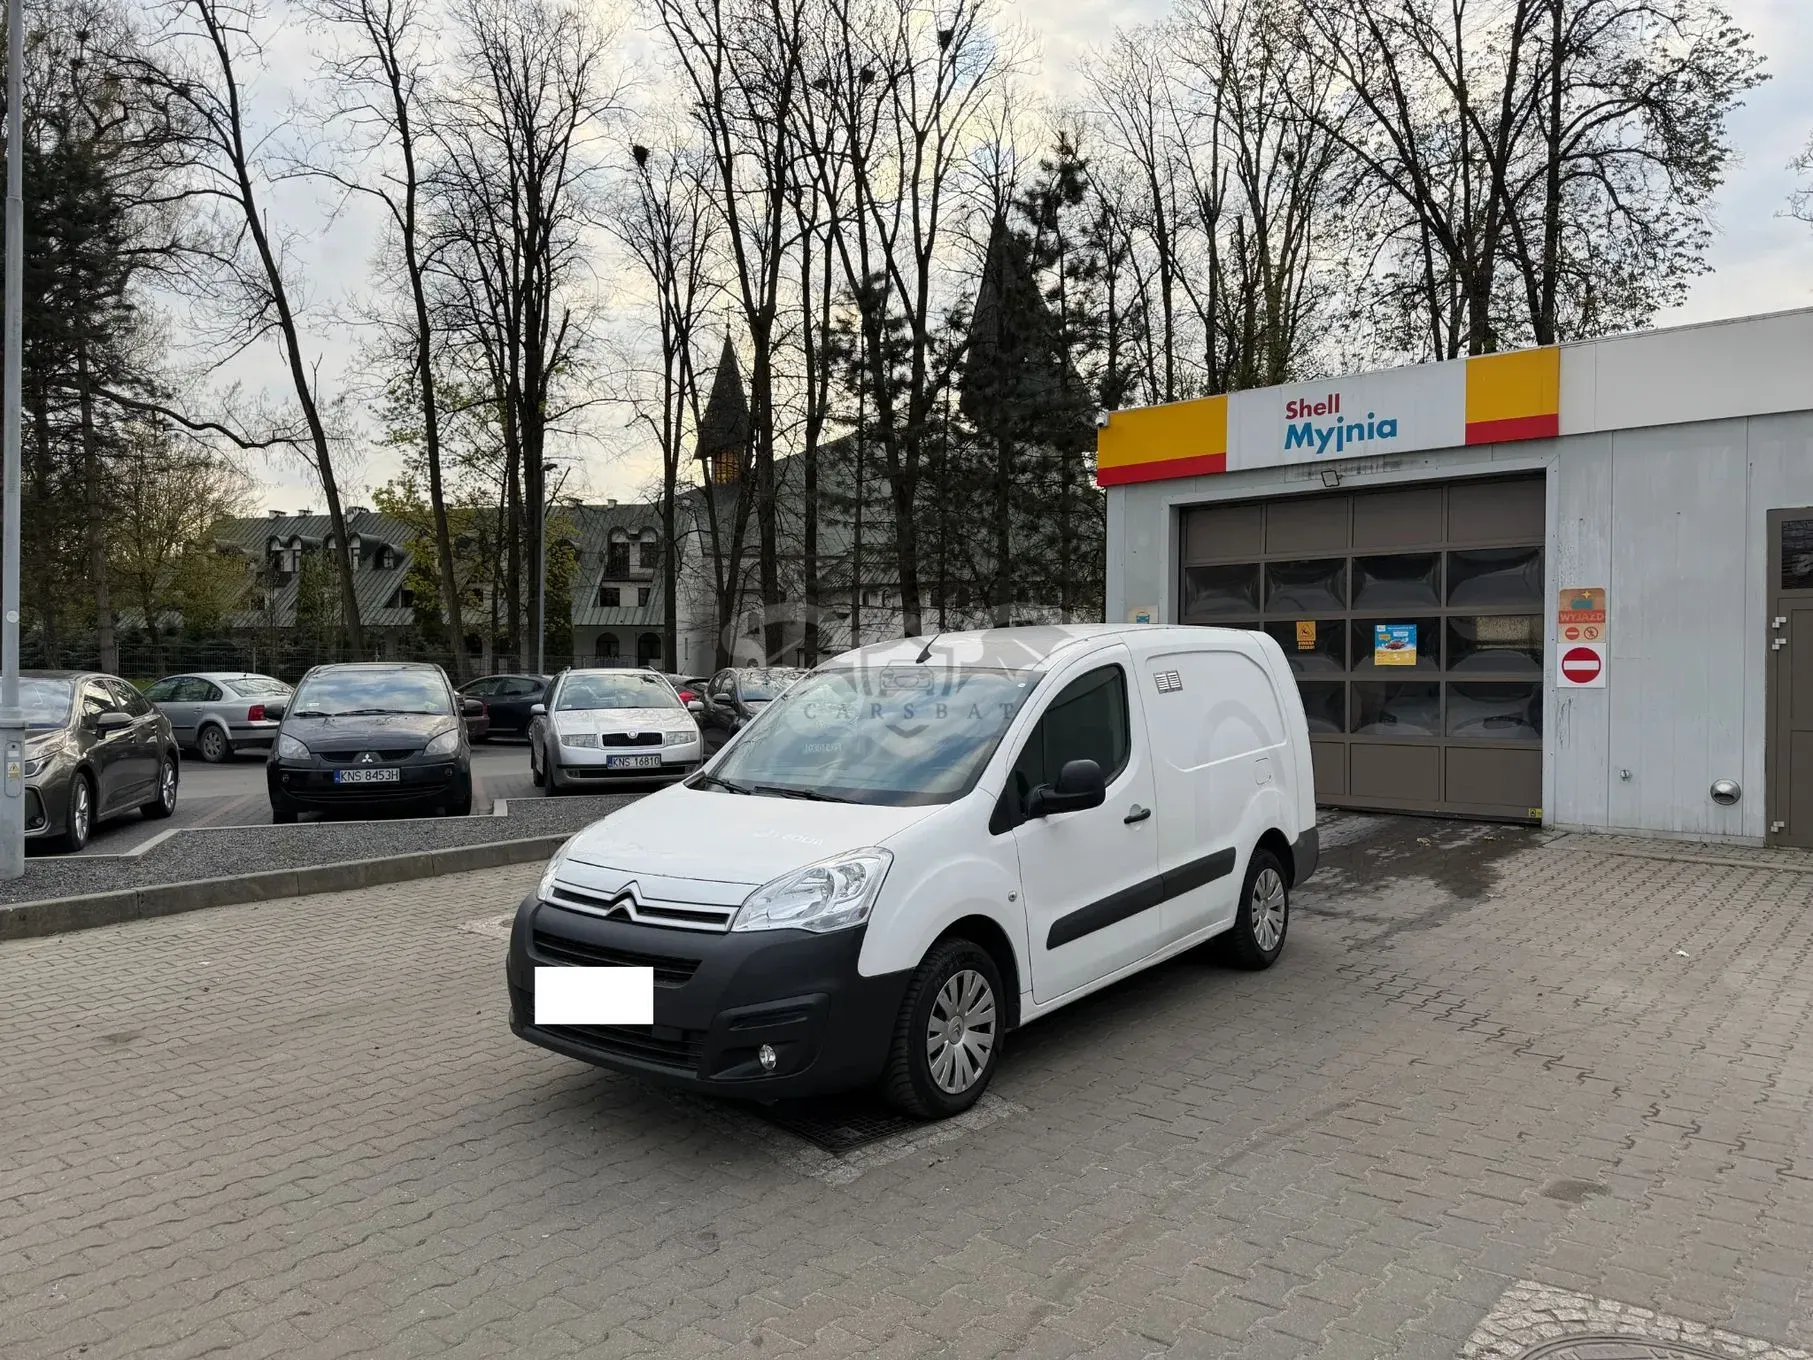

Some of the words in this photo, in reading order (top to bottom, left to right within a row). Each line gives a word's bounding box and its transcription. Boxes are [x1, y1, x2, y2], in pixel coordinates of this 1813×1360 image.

[1285, 393, 1340, 419] Shell
[1284, 412, 1398, 454] Myjnia
[1560, 612, 1603, 622] WYJAZD
[613, 757, 631, 767] KNS
[635, 756, 660, 766] 16810
[340, 771, 362, 782] KNS
[365, 769, 399, 781] 8453H
